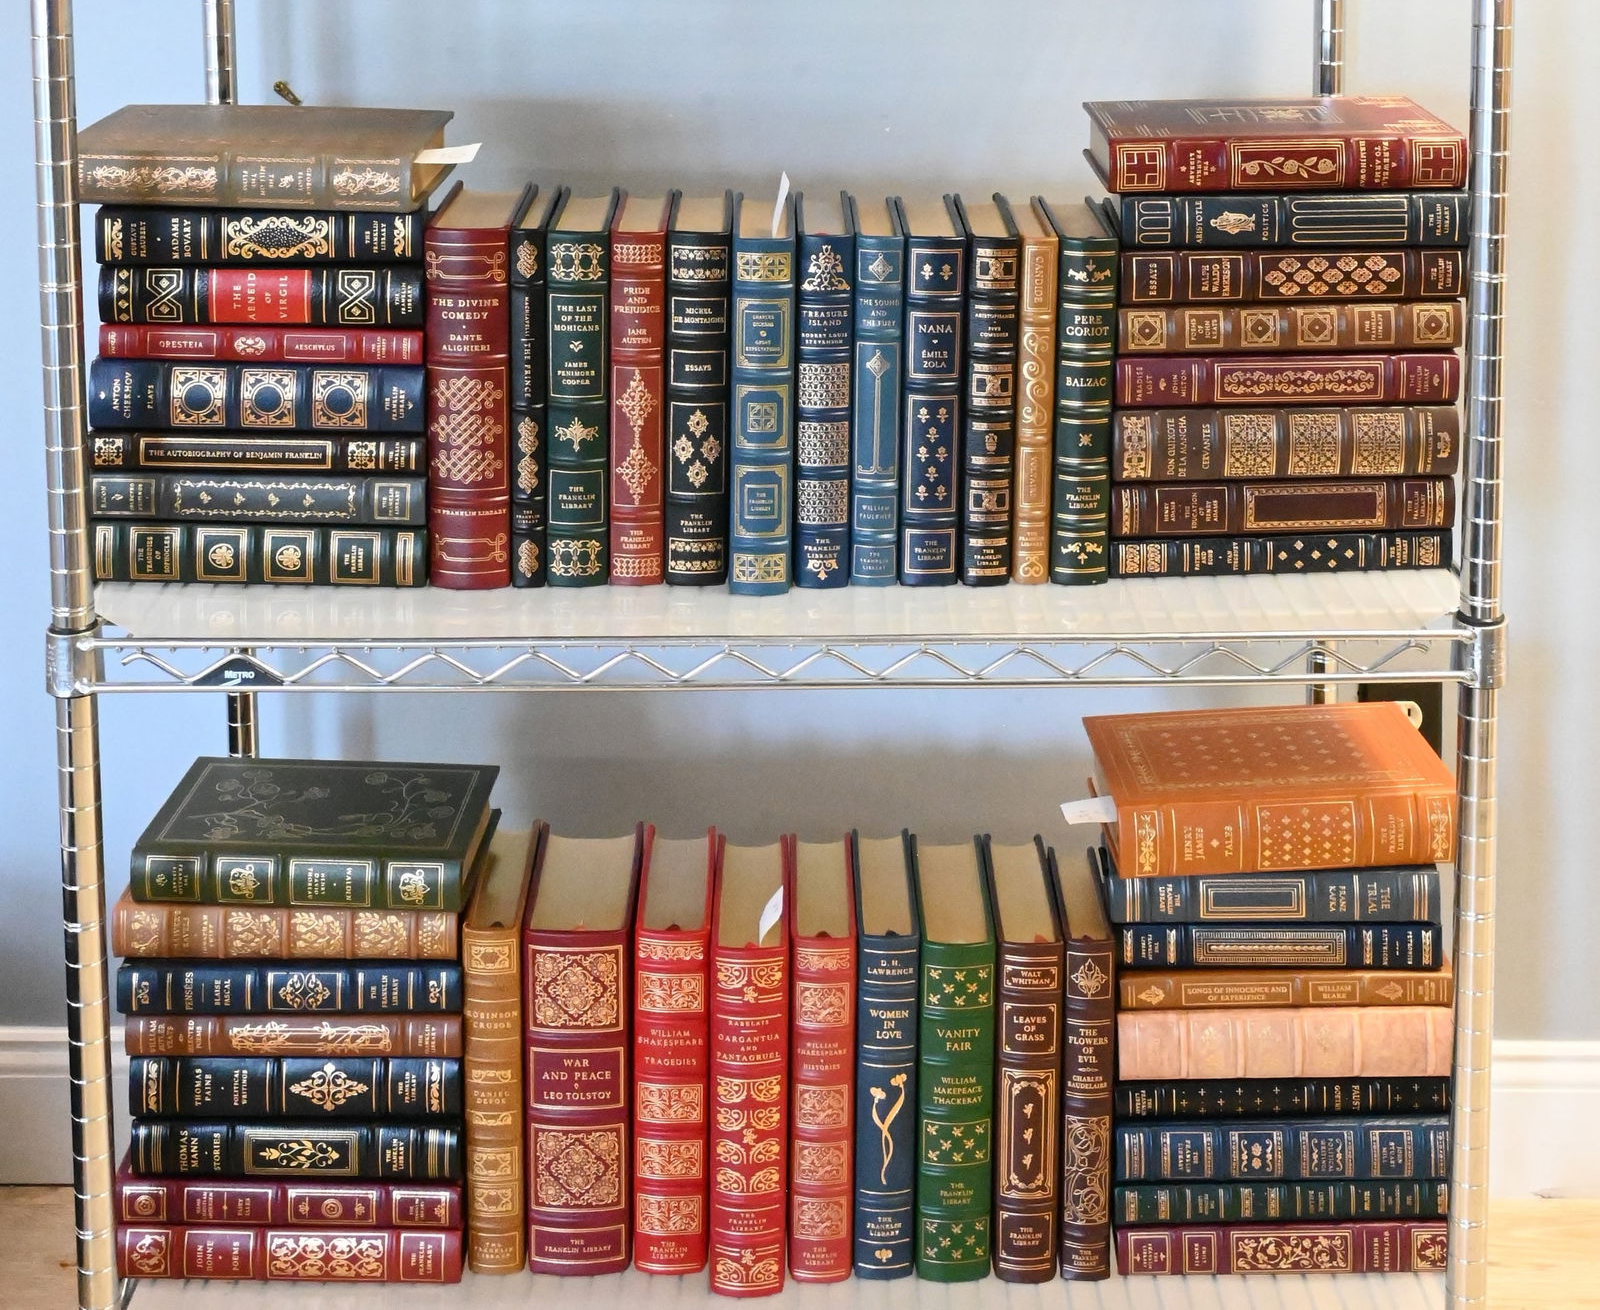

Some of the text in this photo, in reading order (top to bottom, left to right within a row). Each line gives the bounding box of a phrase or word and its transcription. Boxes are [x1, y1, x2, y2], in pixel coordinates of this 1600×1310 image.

[232, 284, 241, 309] THE
[247, 272, 256, 320] AENEID
[265, 291, 272, 303] OF
[458, 298, 499, 307] DIVINE
[614, 305, 660, 314] PREJUDICE
[442, 311, 488, 320] COMEDY
[919, 324, 952, 333] NANA
[1066, 326, 1109, 336] GORIOT
[922, 349, 948, 359] ÉMILE
[923, 360, 946, 368] ZOLA
[1066, 377, 1106, 386] BALZAC
[166, 450, 230, 458] AUTOBIOGRAPHY
[1367, 883, 1377, 914] TRIAL
[1381, 889, 1389, 909] THE
[1012, 977, 1050, 985] WHITMAN
[870, 1010, 908, 1019] WOMEN
[1013, 1016, 1046, 1024] LEAVES
[877, 1031, 902, 1039] LOVE
[937, 1029, 980, 1039] VANITY
[1069, 1036, 1108, 1045] FLOWERS
[947, 1042, 971, 1051] FAIR
[575, 1071, 611, 1080] PEACE
[942, 1076, 976, 1084] WILLIAM
[565, 1091, 611, 1099] TOLSTOY
[933, 1096, 982, 1104] THACKERAY
